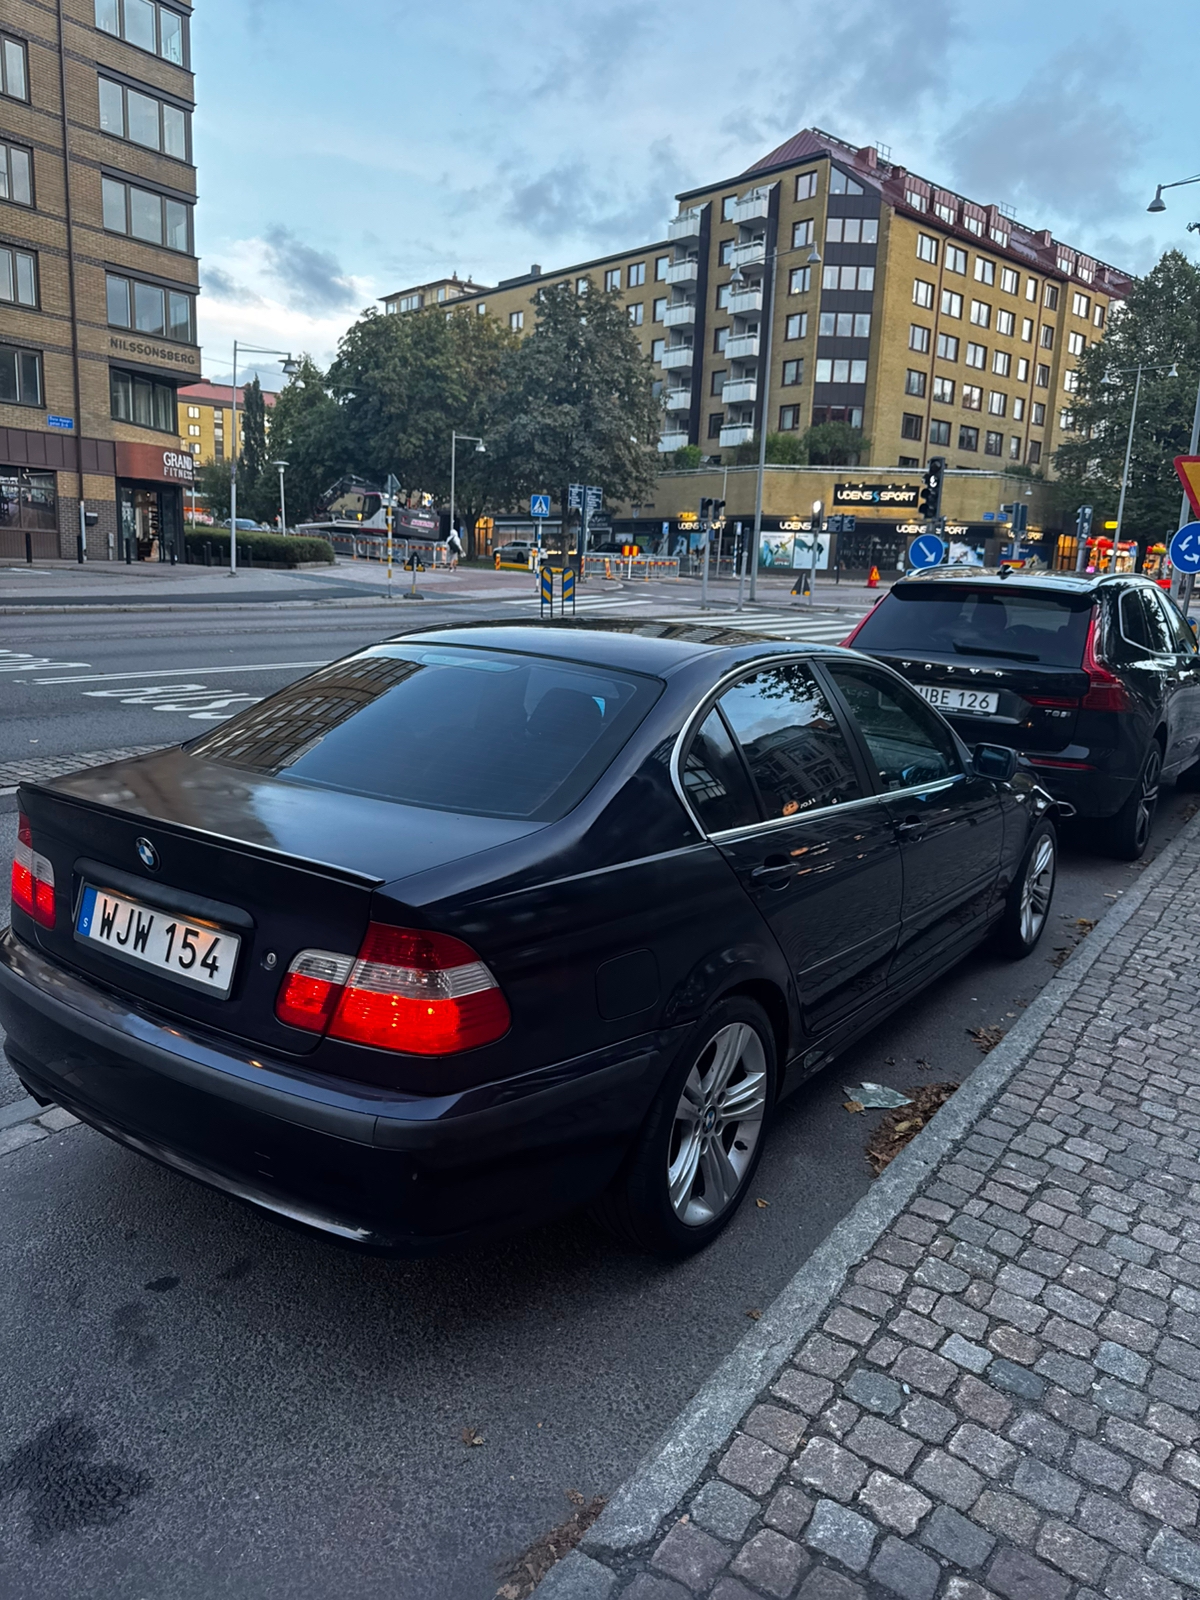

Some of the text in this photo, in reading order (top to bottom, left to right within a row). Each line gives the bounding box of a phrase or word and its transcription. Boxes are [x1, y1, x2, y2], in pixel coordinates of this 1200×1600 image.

[110, 338, 195, 365] NILSSONSBERG
[163, 452, 193, 471] GRAND
[163, 467, 193, 480] FITNESS
[837, 491, 916, 501] UDENS SPORT
[677, 522, 699, 530] UDENS
[779, 521, 812, 530] UDENS
[902, 661, 1003, 678] VOLVO
[958, 691, 990, 710] 126
[83, 917, 89, 927] S
[100, 898, 221, 979] WJW 154
